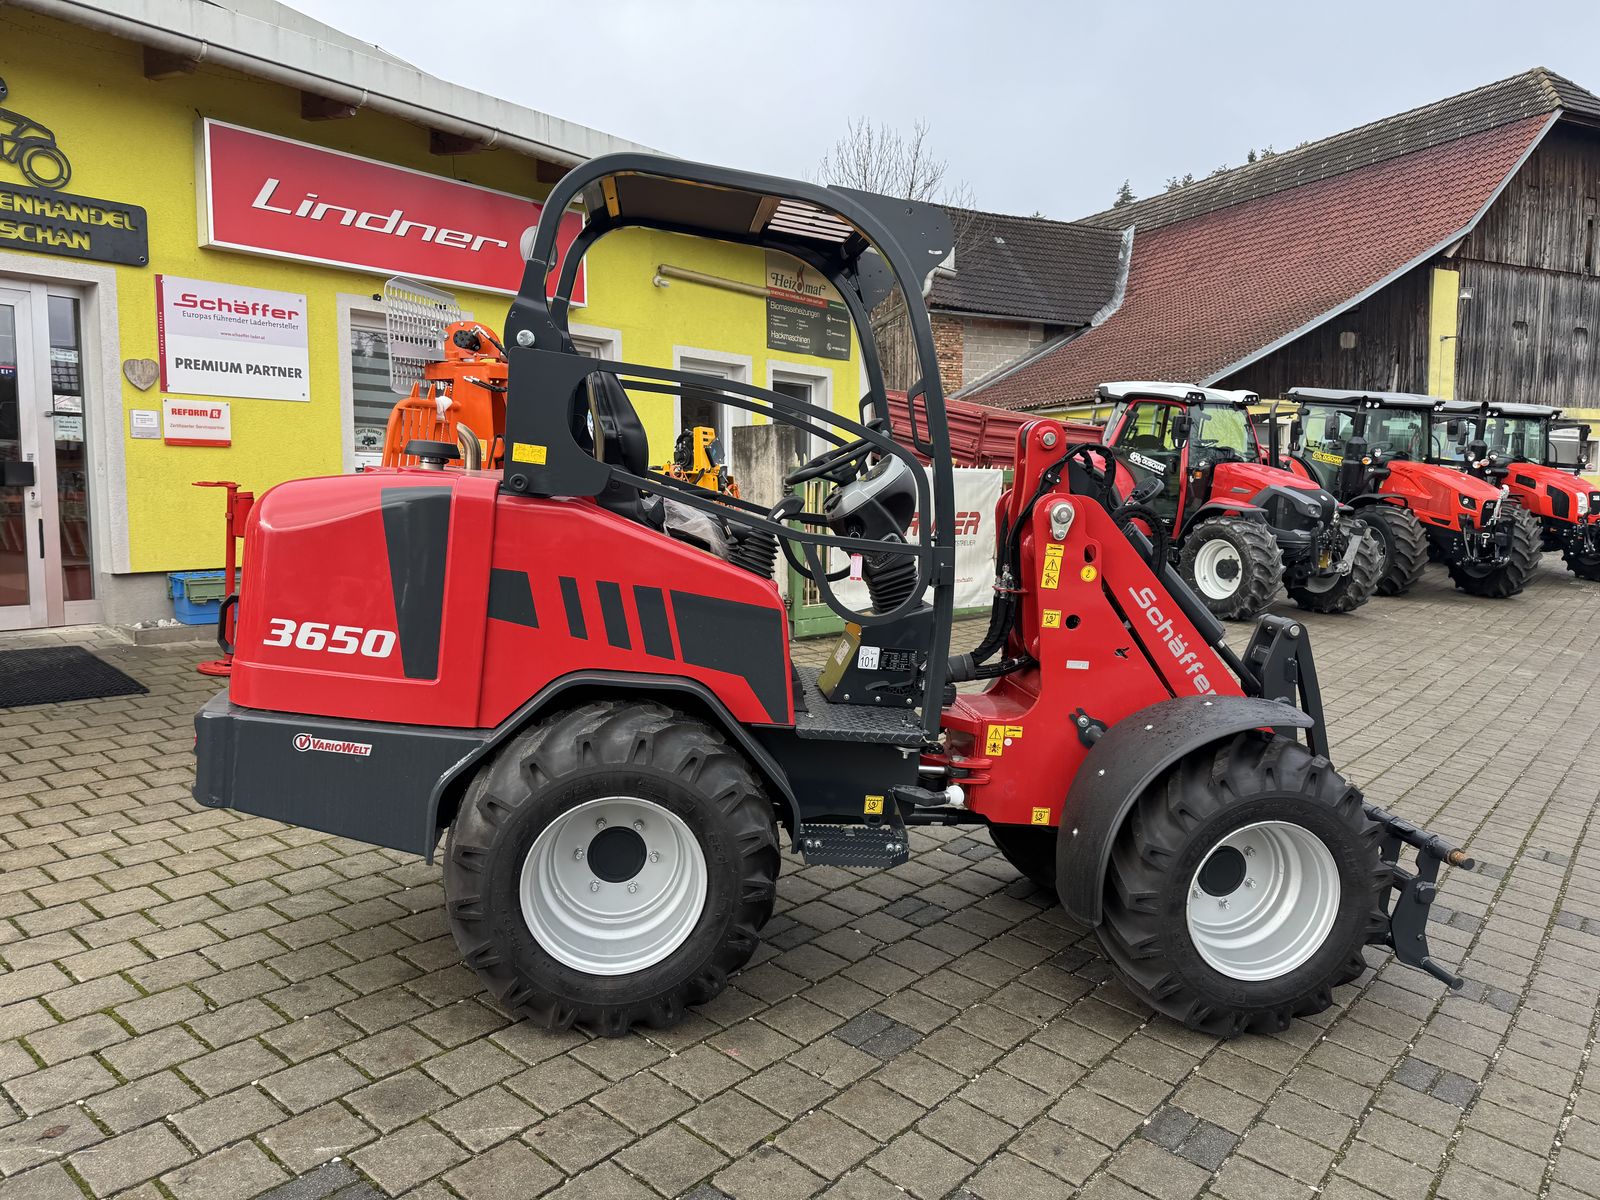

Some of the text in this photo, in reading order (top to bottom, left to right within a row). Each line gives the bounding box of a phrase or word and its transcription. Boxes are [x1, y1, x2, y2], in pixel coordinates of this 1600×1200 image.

[252, 178, 508, 252] Lindner
[173, 293, 299, 321] Schäffer
[182, 311, 299, 331] Europas führender Laderhersteller
[770, 330, 811, 344] Hackmaschinen
[175, 357, 302, 379] PREMIUM PARTNER
[171, 407, 208, 417] REFORM
[263, 617, 396, 658] 3650
